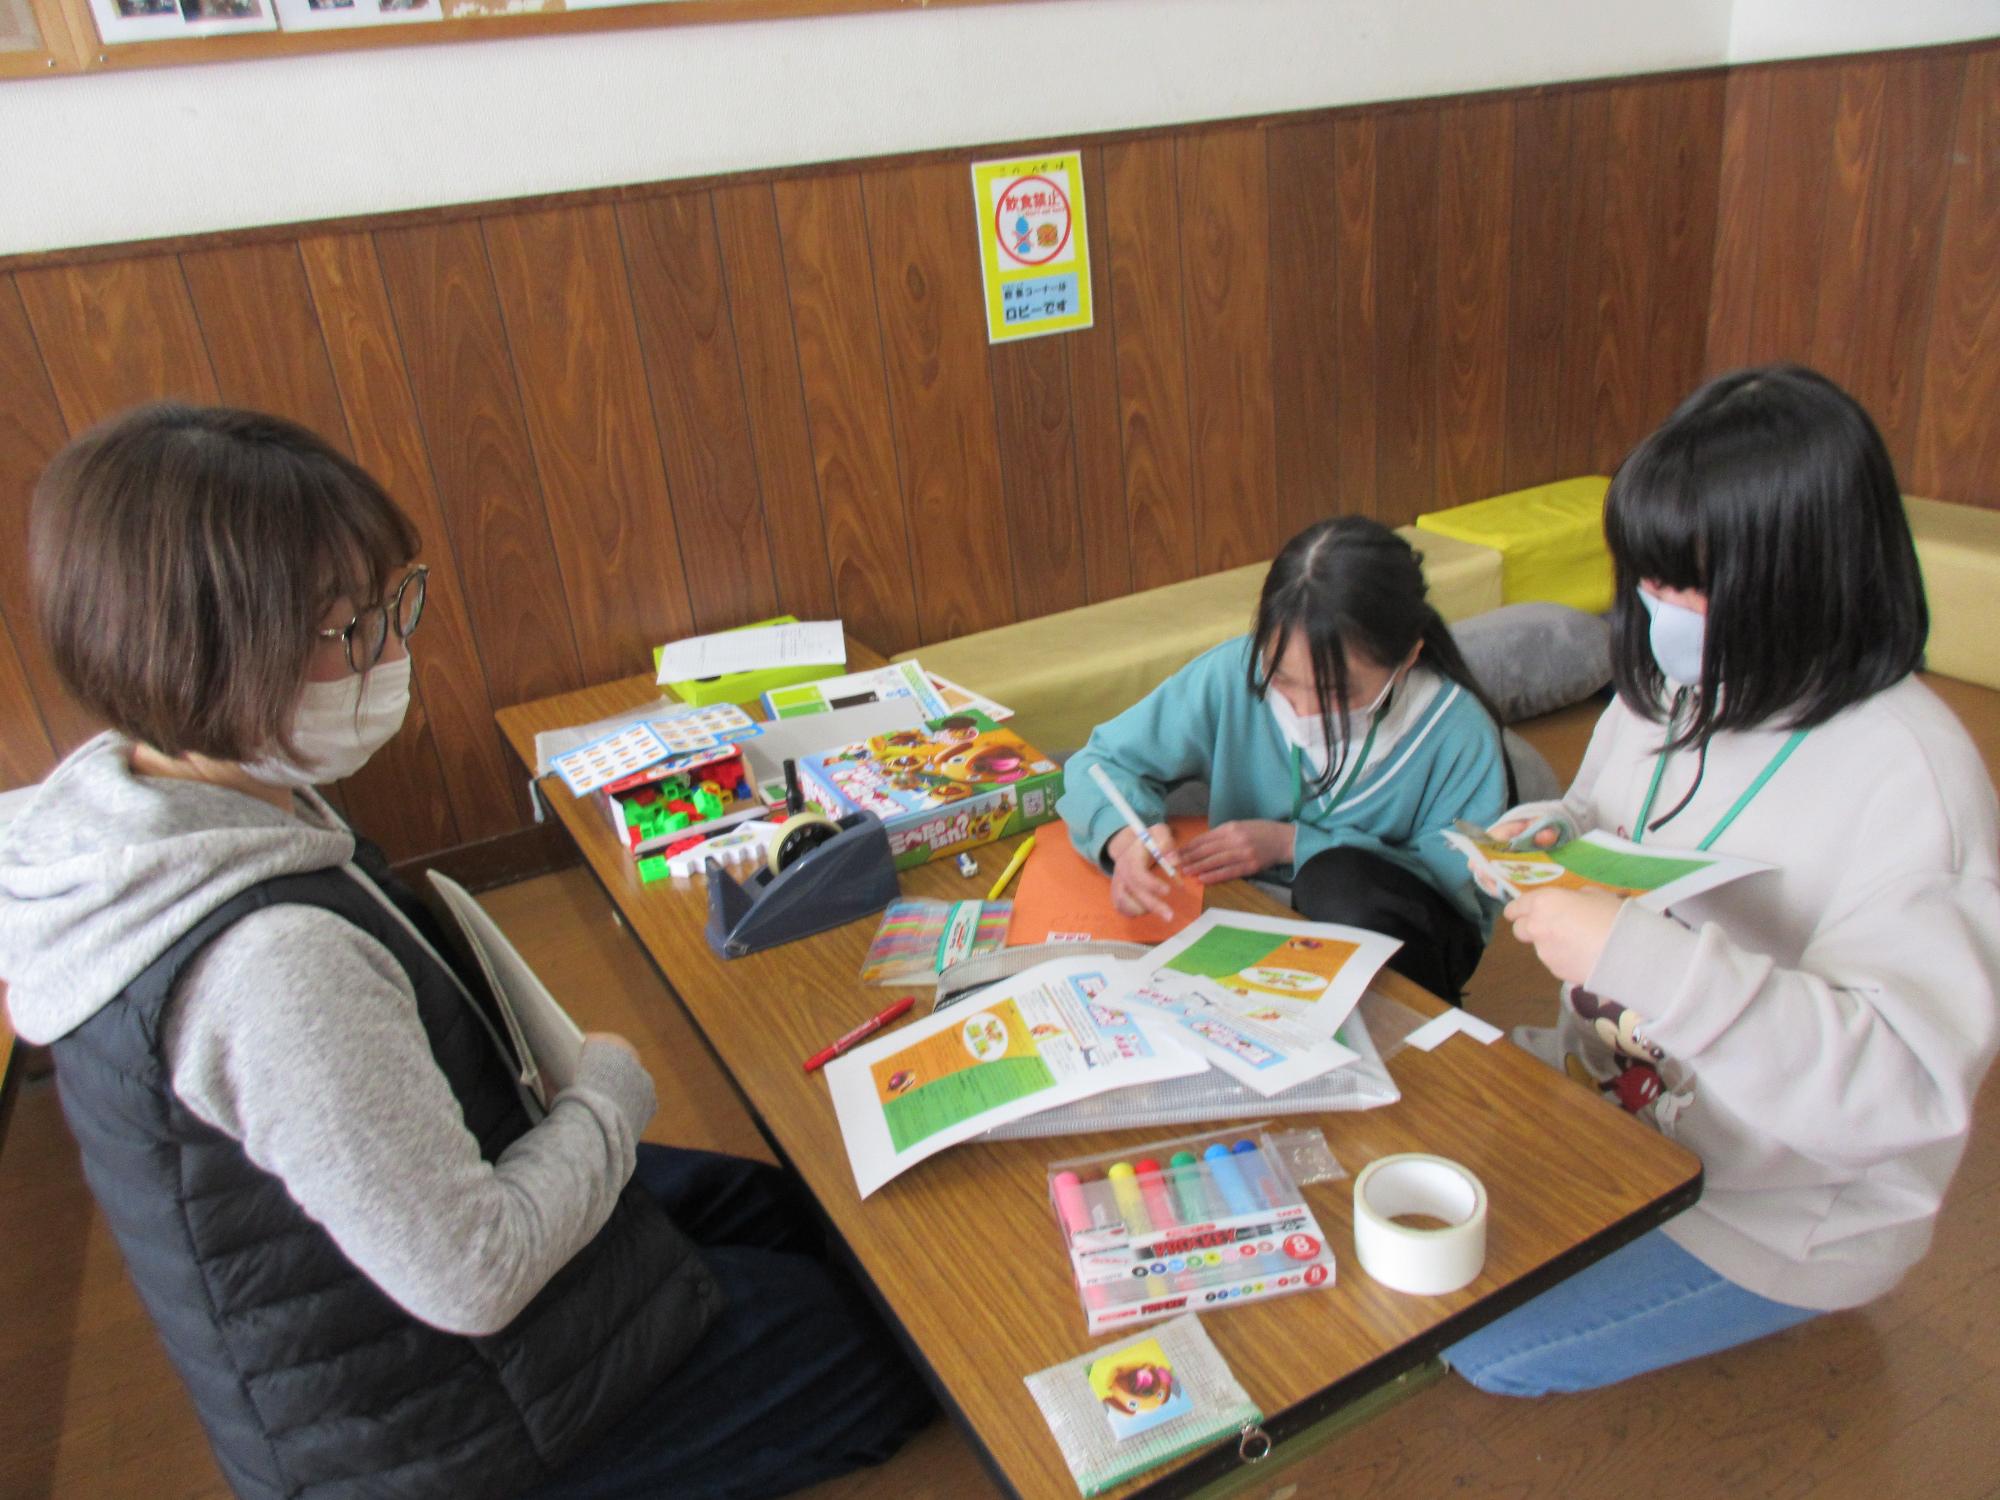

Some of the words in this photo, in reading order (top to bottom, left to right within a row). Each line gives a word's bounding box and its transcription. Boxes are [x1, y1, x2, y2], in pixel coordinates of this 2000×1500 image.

[1006, 190, 1059, 211] 飲食禁止
[1006, 299, 1066, 320] ロビーです
